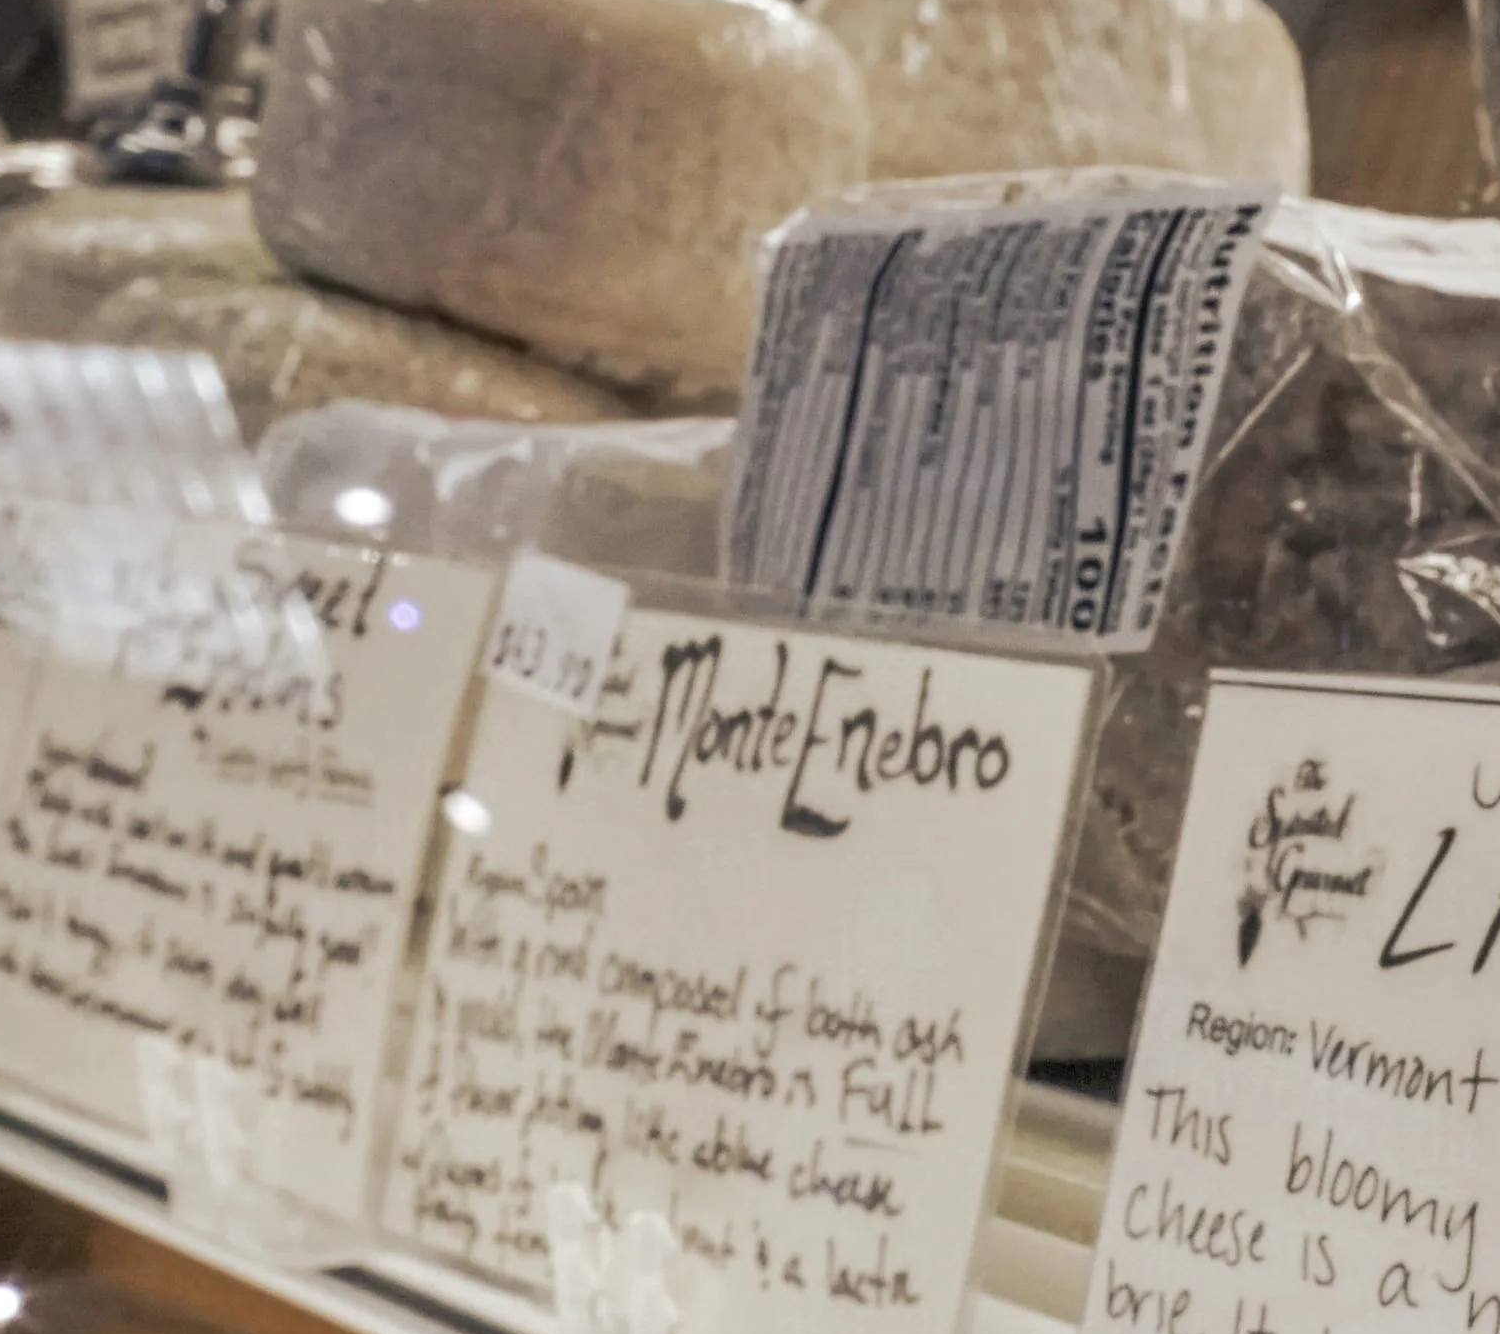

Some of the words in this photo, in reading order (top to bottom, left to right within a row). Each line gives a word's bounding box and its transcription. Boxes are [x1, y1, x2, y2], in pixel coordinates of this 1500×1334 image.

[1178, 204, 1263, 449] Nutrition
[1072, 516, 1108, 633] 100
[638, 632, 798, 822] Monte
[780, 655, 1010, 837] Enebro
[1186, 1002, 1299, 1058] Region:
[1309, 1018, 1500, 1114] Vermont
[1145, 1084, 1234, 1167] This
[1285, 1121, 1480, 1293] bloomy
[1301, 1231, 1337, 1287] is
[1379, 1262, 1420, 1308] a
